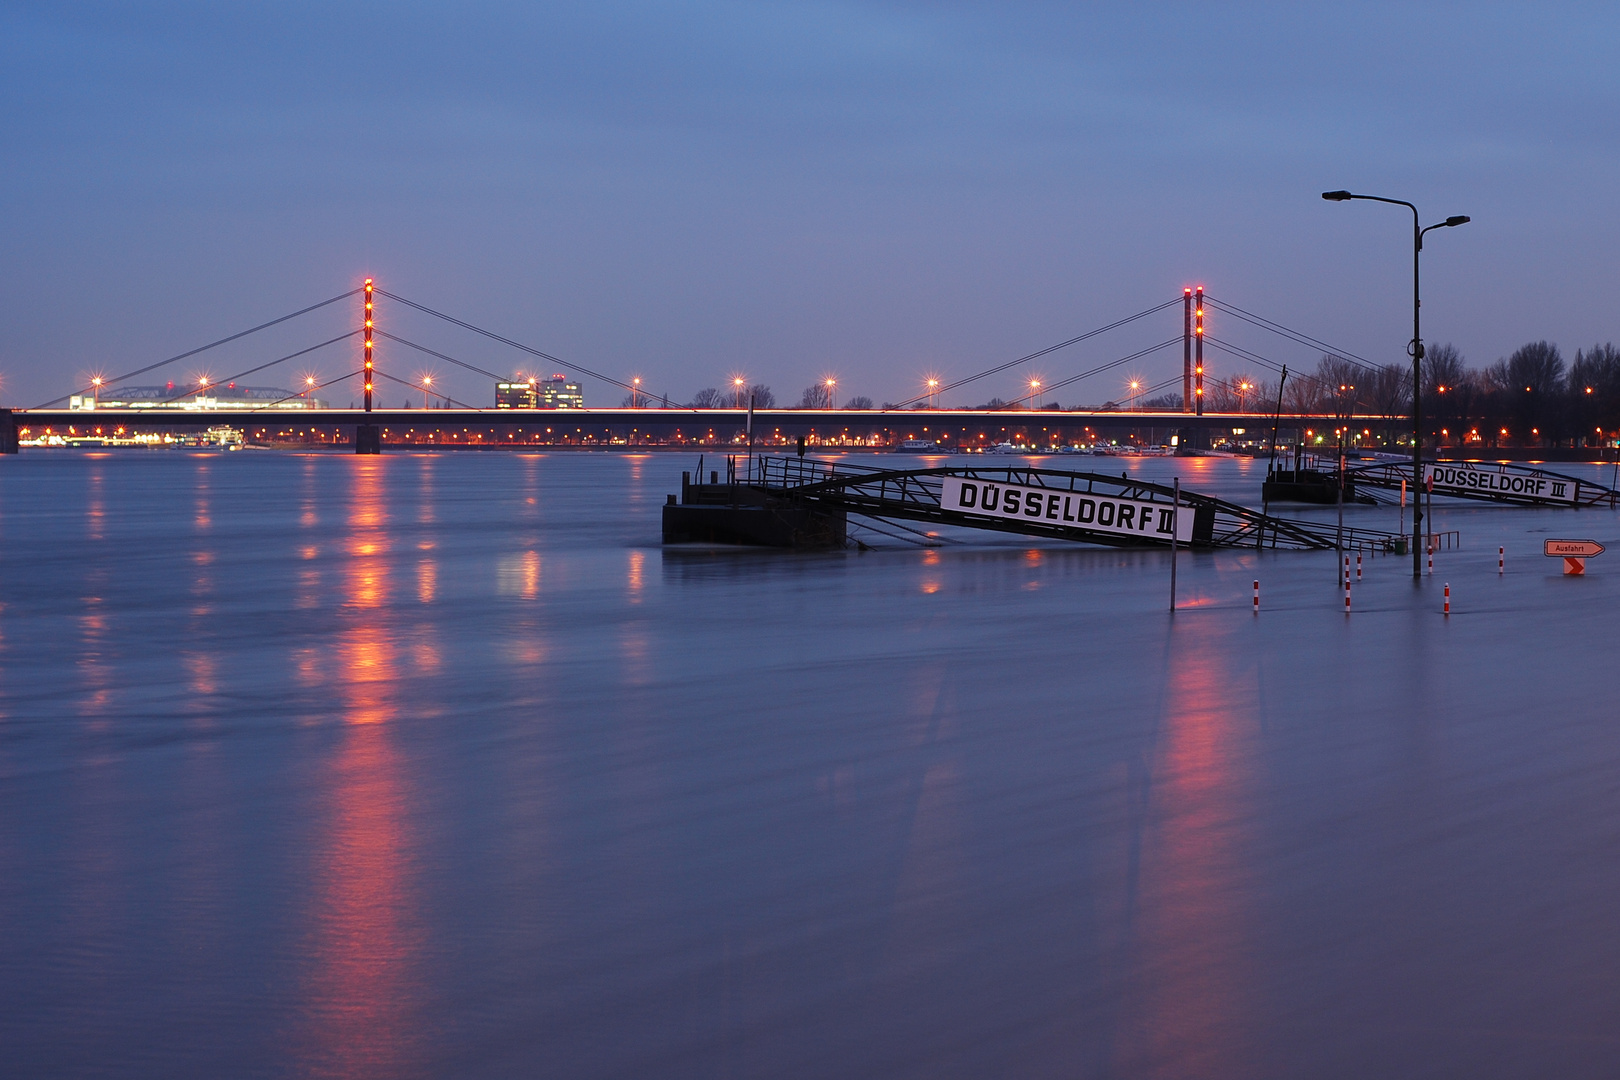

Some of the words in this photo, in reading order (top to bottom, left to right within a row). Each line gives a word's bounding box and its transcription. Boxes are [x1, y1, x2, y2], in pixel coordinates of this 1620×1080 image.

[1433, 467, 1546, 494] DÜSSELDORF
[1550, 482, 1567, 498] III
[959, 483, 1153, 531] DÜSSELDORF
[1156, 508, 1174, 535] II
